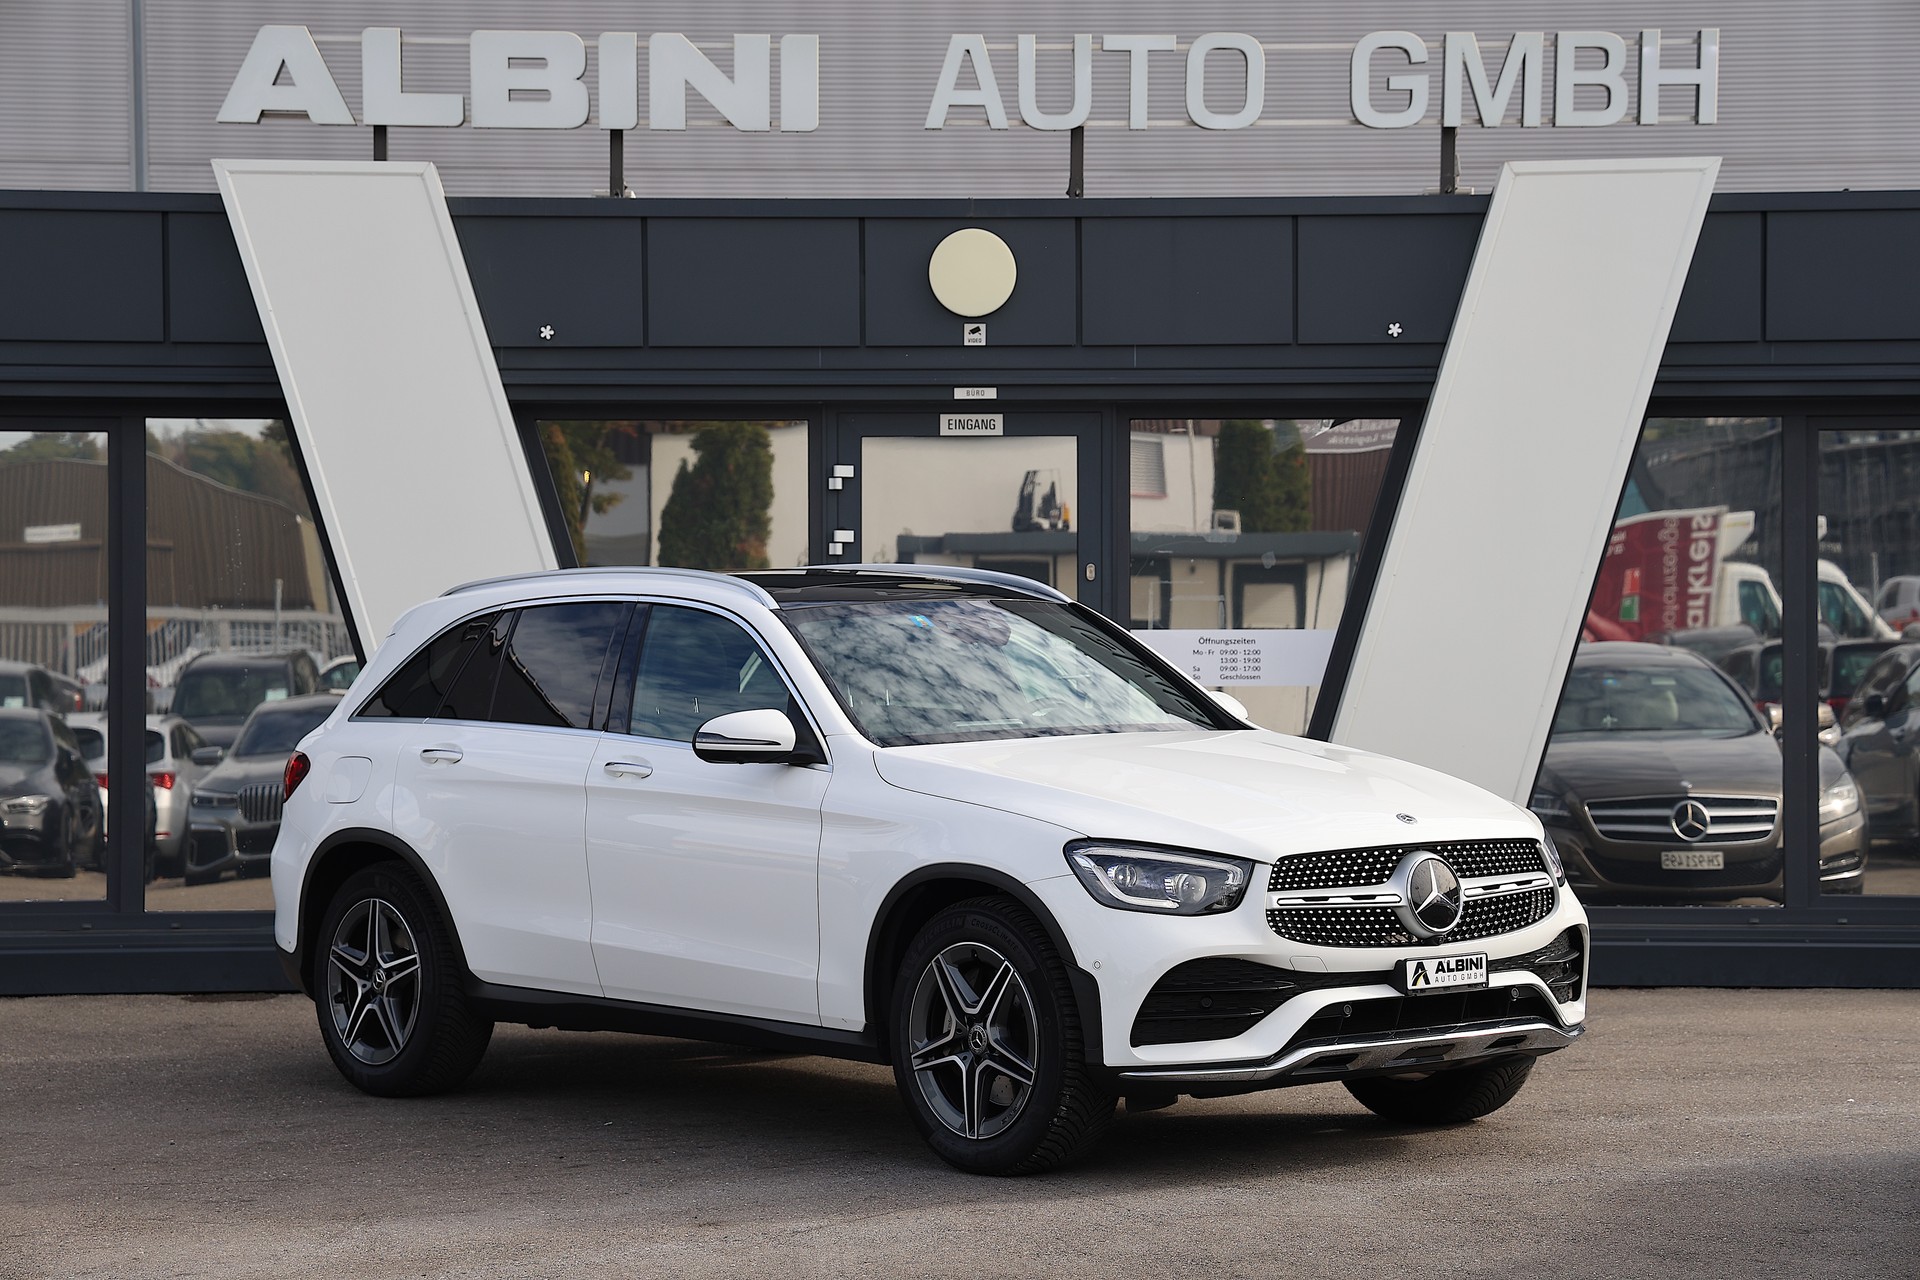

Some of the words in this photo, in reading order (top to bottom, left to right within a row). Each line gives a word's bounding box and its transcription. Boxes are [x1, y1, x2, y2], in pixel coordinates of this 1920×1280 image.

[215, 24, 820, 133] ALBINI
[924, 31, 1266, 131] AUTO
[1349, 27, 1721, 130] GMBH
[966, 388, 985, 397] BÜRO
[947, 418, 996, 431] EINGANG
[1198, 636, 1256, 646] Öffnungszeiten
[1434, 956, 1483, 974] ALBINI
[1434, 974, 1457, 983] AUTO
[1460, 972, 1484, 981] GMBH
